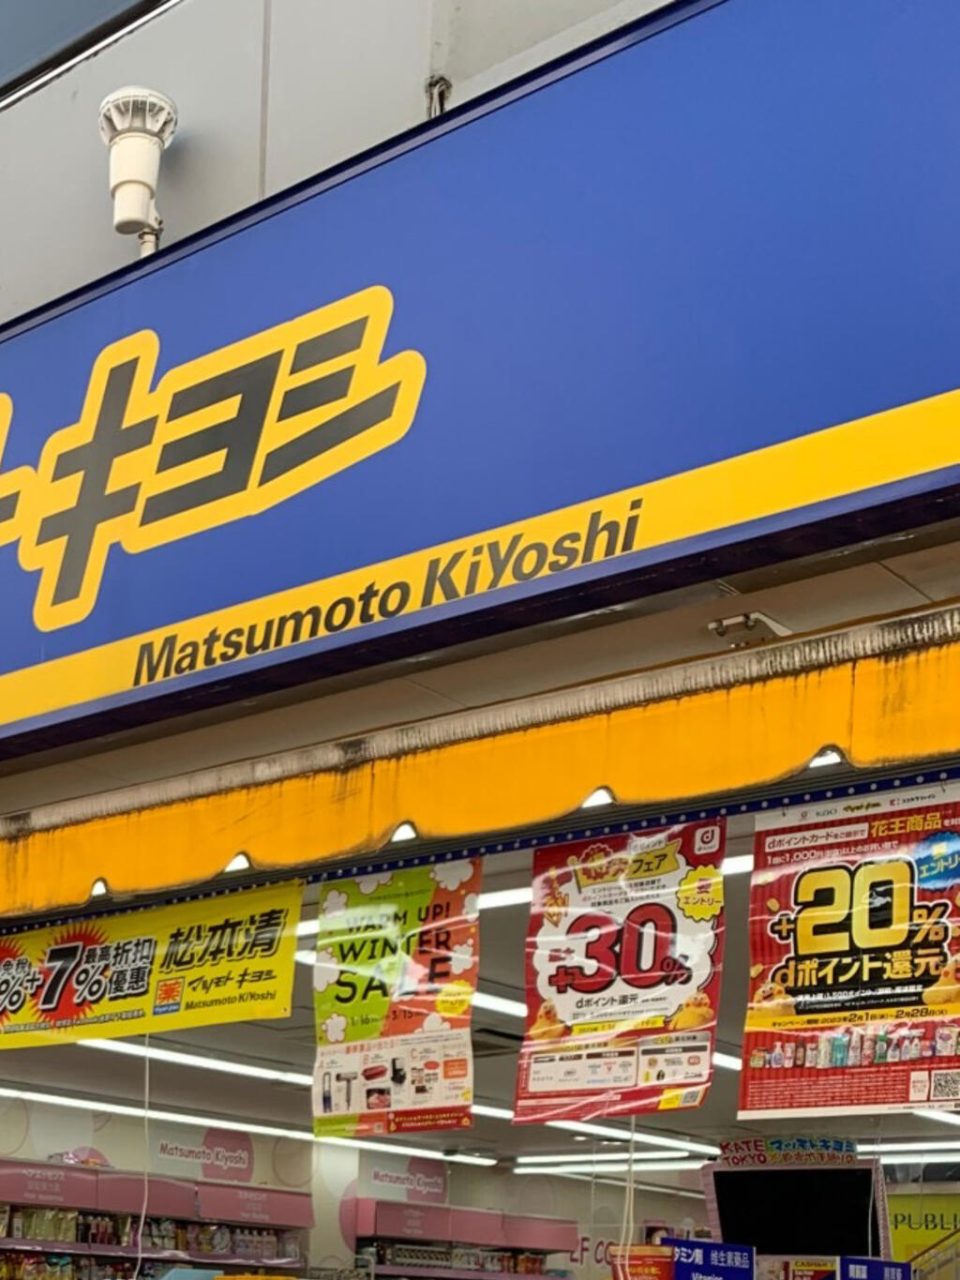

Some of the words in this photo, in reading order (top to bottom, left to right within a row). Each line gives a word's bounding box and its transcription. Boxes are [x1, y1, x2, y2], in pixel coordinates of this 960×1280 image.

[133, 579, 410, 688] Matsumoto
[421, 498, 644, 607] KiYoshi
[871, 812, 942, 838] 花王商品
[418, 902, 452, 922] UP!
[159, 908, 289, 975] 松本清
[338, 926, 452, 963] WINTER
[772, 949, 945, 989] dポイント還元
[184, 995, 237, 1011] Matsumoto
[159, 1142, 213, 1161] Matsumoto
[215, 1147, 248, 1169] Kiyoshi
[719, 1139, 765, 1155] KATE
[722, 1152, 767, 1166] TOKYO
